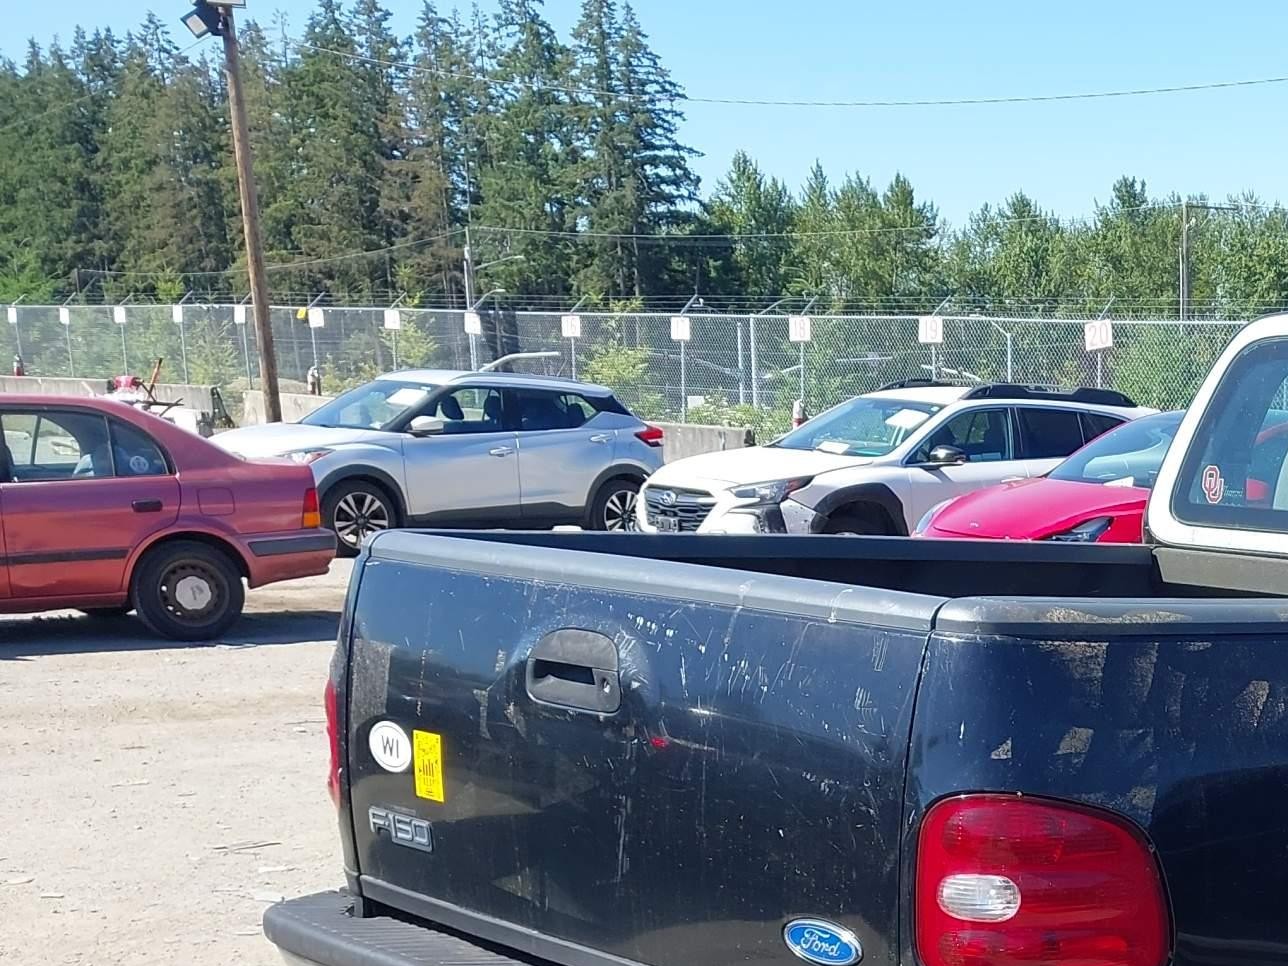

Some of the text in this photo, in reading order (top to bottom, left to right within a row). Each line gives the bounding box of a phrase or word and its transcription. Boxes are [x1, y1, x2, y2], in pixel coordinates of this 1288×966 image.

[794, 318, 806, 338] 18
[924, 319, 938, 340] 19
[1088, 324, 1109, 347] 20
[381, 735, 400, 759] WI
[800, 929, 840, 957] Ford
